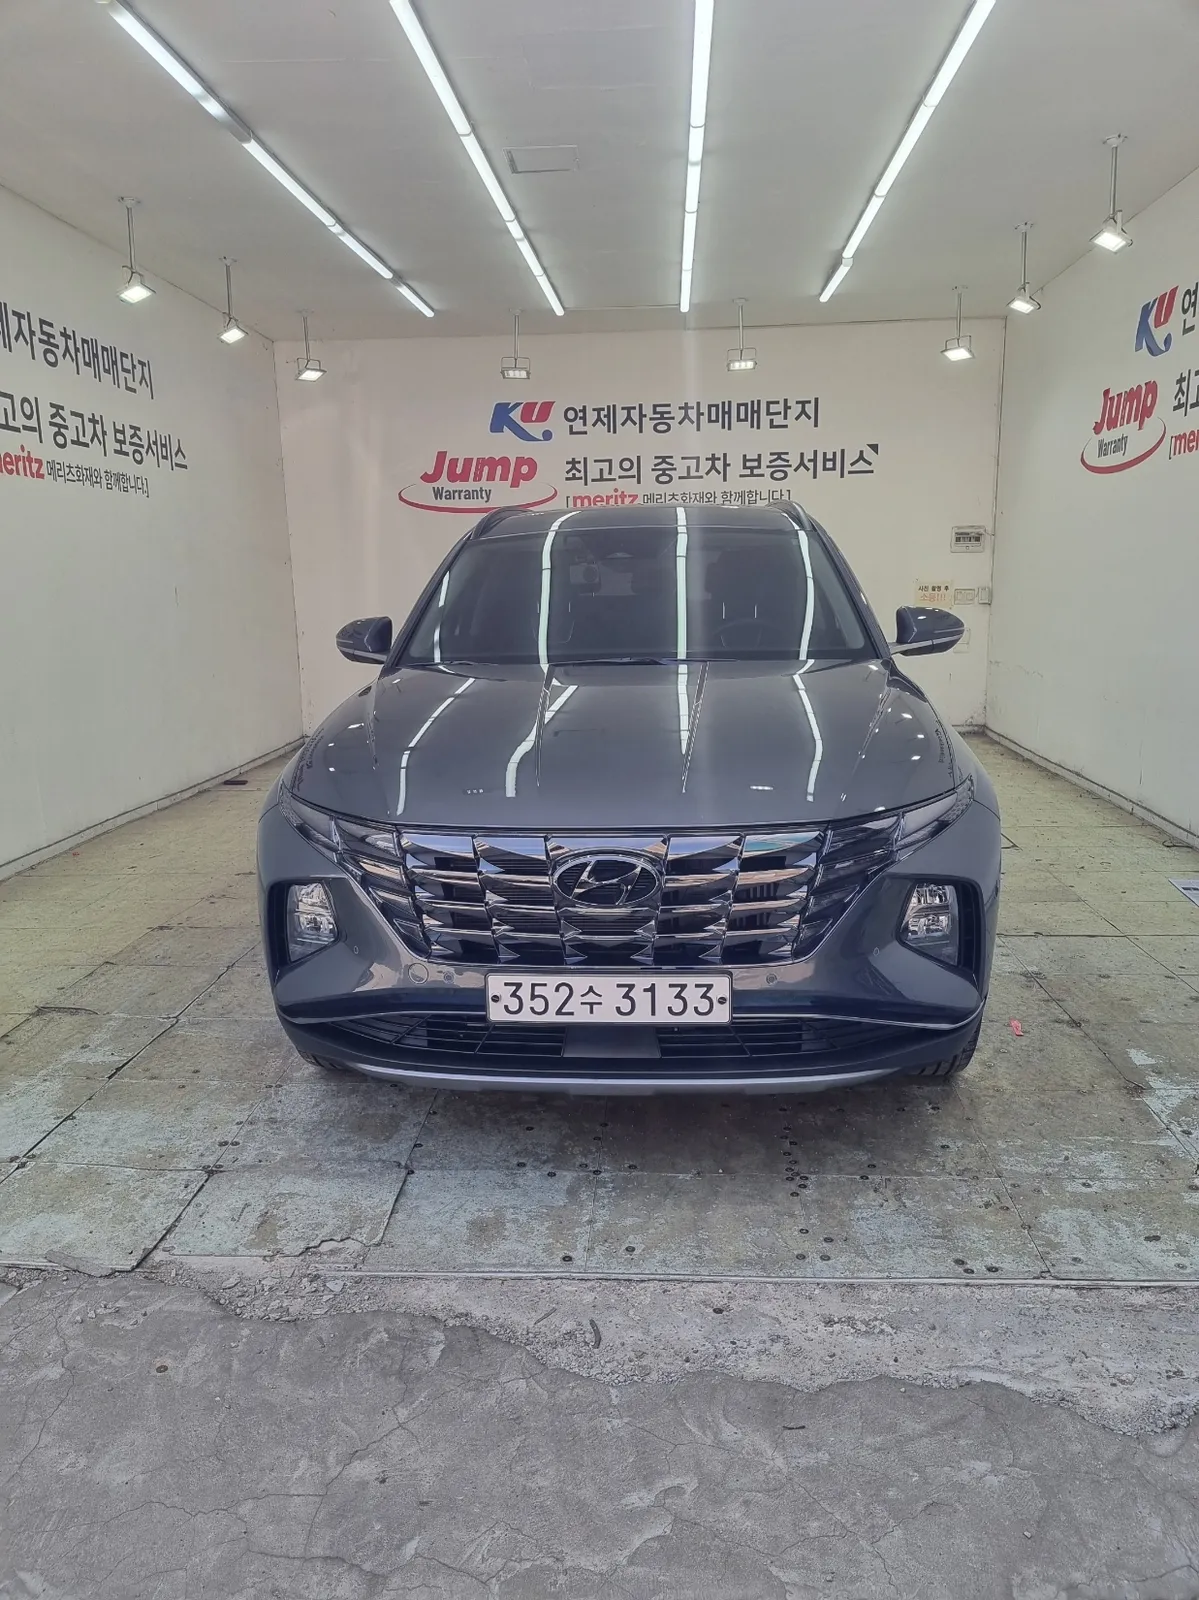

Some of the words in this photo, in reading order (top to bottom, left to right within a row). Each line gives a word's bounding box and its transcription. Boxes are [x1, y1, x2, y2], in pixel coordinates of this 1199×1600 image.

[563, 397, 819, 435] 연제자동차매매단지
[1092, 379, 1158, 435] Jump
[48, 402, 108, 457] 중고차
[112, 421, 188, 471] 보증서비스
[1097, 433, 1129, 459] Warranty
[0, 444, 45, 480] eritz
[46, 459, 102, 489] 메리츠화재와
[420, 451, 537, 488] Jump
[565, 455, 642, 486] 최고의
[651, 452, 731, 485] 중고차
[739, 448, 874, 481] 보증서비스
[432, 486, 492, 503] Warranty
[503, 982, 603, 1016] 352수
[615, 983, 714, 1016] 3133
